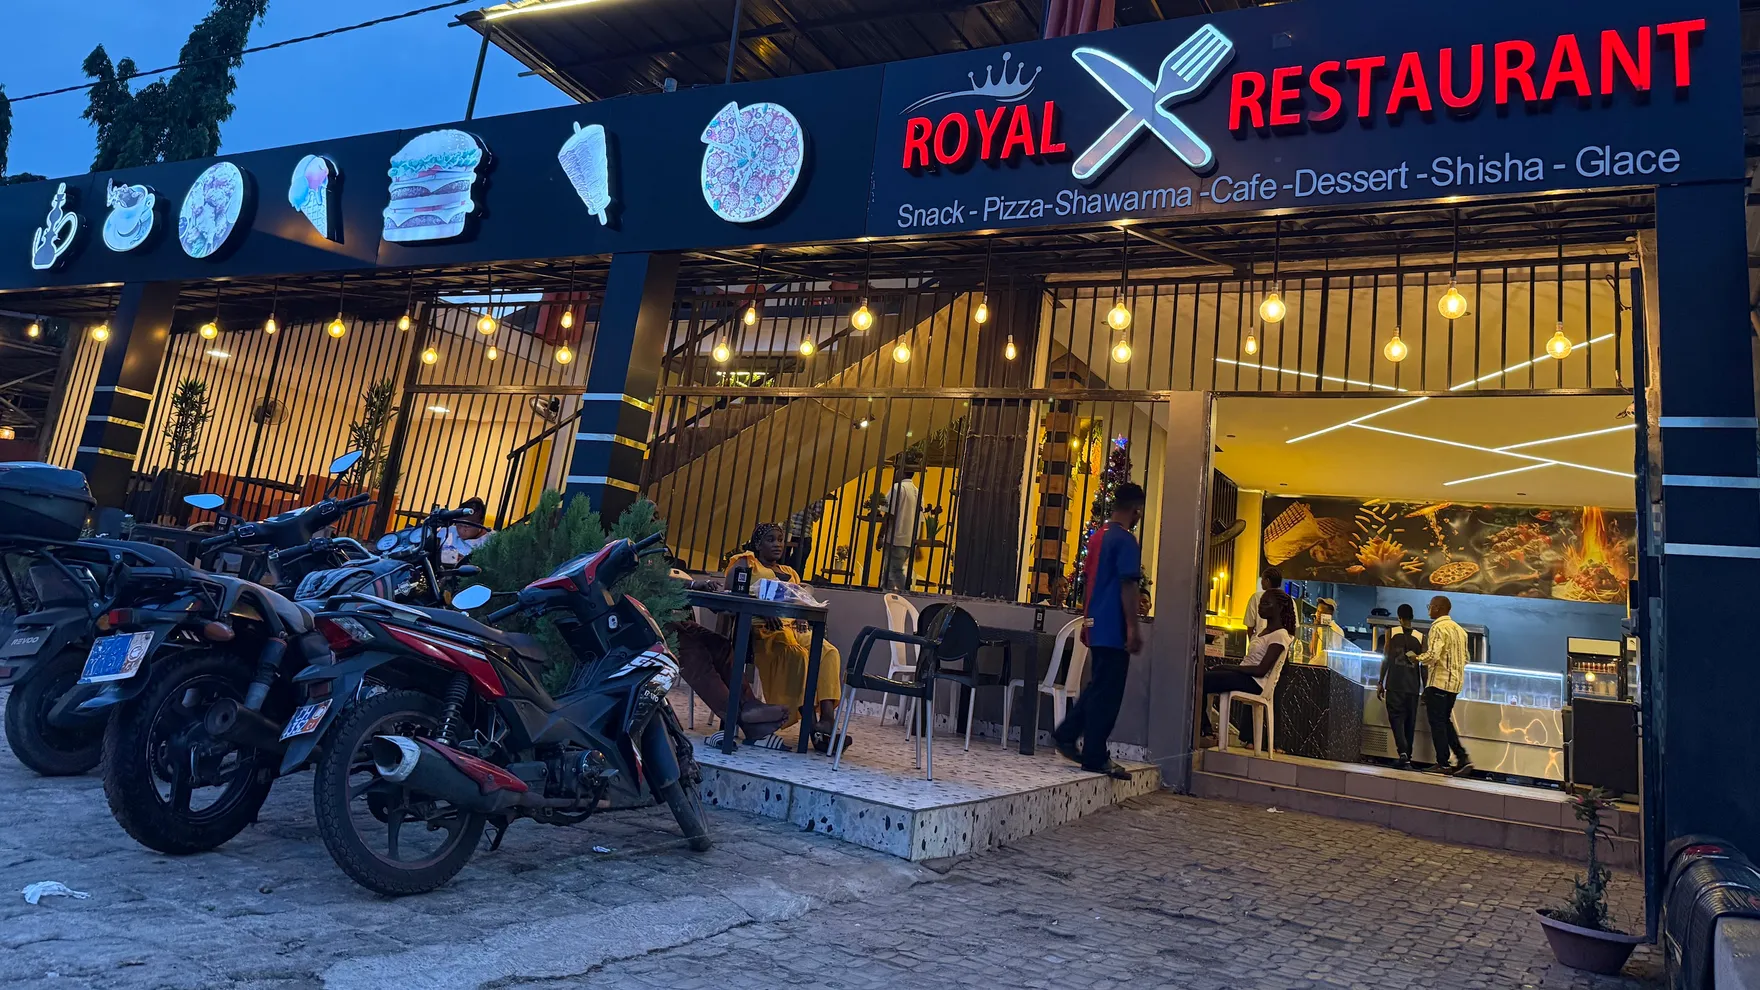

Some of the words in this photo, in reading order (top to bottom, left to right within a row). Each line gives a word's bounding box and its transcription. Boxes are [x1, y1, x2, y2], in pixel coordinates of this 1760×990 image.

[903, 101, 1065, 168] ROYAL
[1229, 19, 1705, 130] RESTAURANT
[897, 200, 965, 228] Snack
[1575, 145, 1681, 178] Glace
